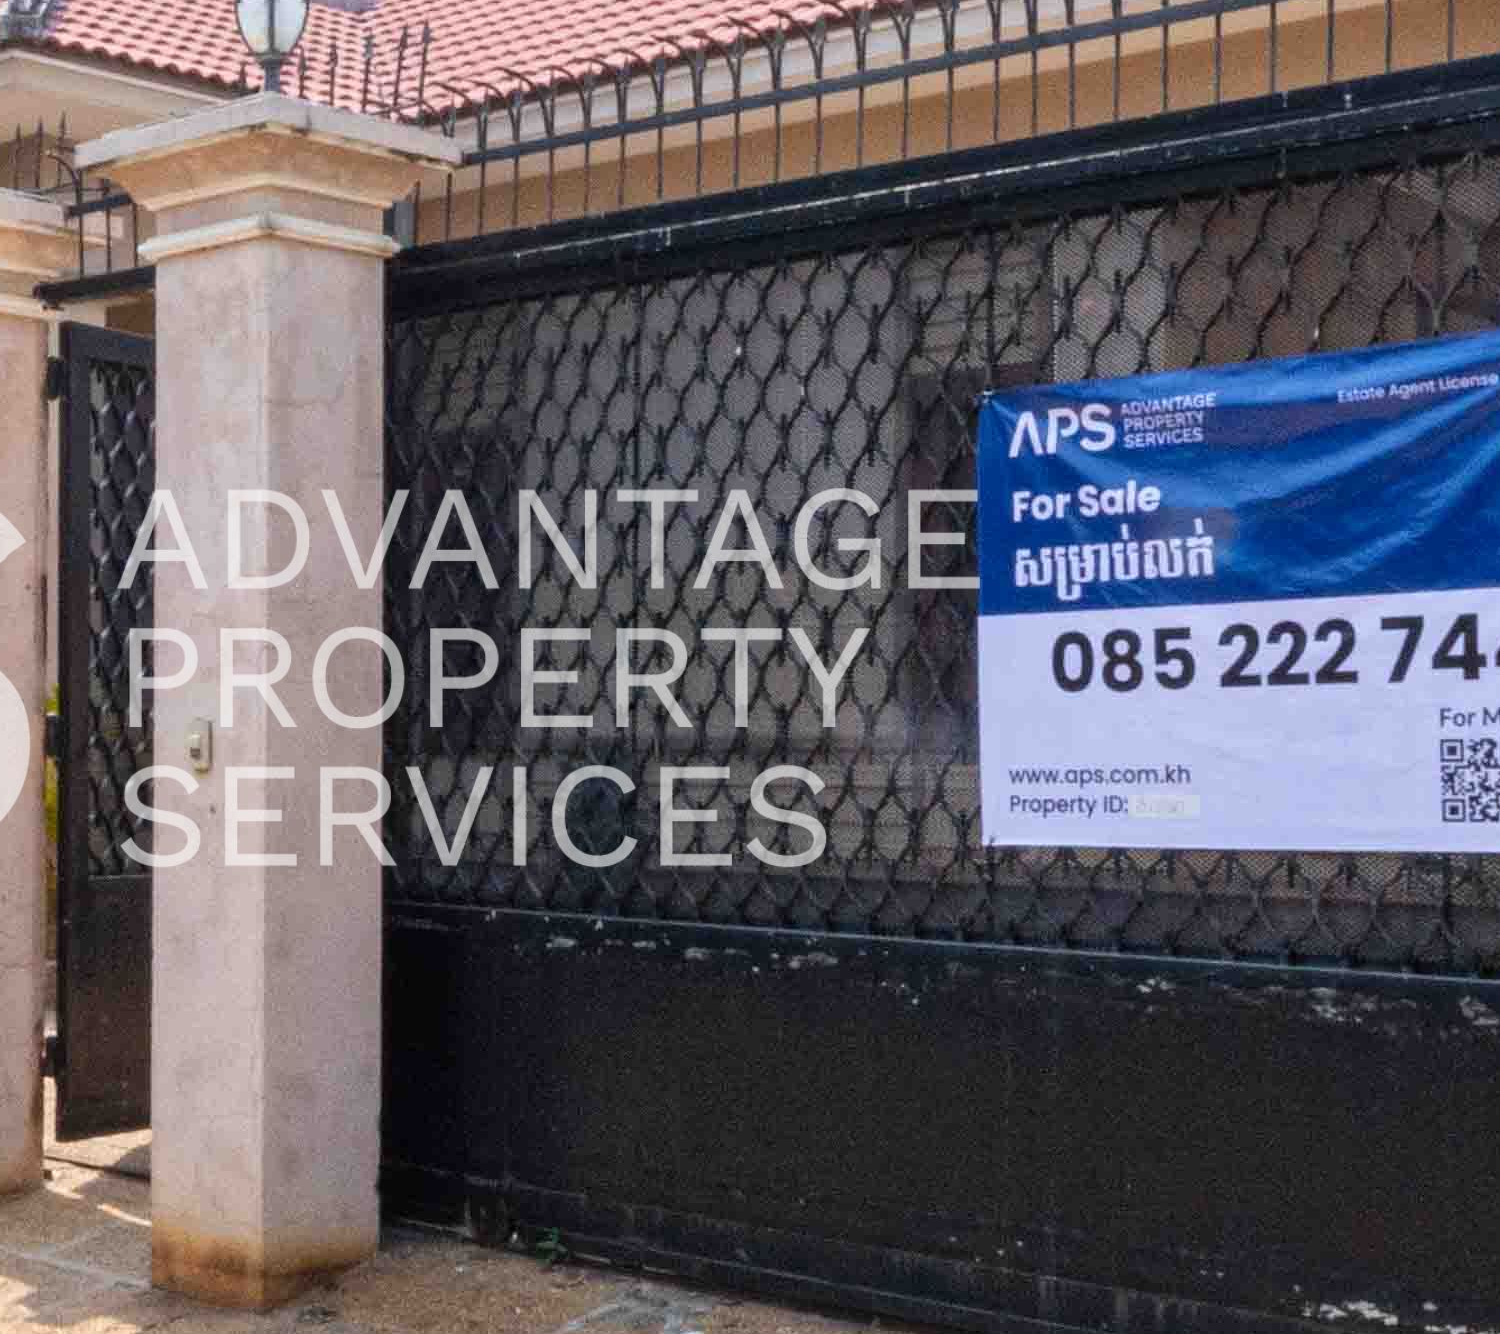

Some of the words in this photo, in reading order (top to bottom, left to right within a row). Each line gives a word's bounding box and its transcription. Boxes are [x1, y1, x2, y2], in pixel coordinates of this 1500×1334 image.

[1337, 387, 1384, 403] Estate
[1389, 380, 1435, 400] Agent
[1439, 374, 1499, 390] License
[1120, 393, 1216, 415] ADVANTAGE
[1008, 403, 1115, 458] APS
[1122, 411, 1204, 432] PROPERTY
[1123, 428, 1204, 449] SERVICES
[1012, 491, 1071, 522] For
[1077, 479, 1161, 517] Sale
[1051, 628, 1196, 692] 085
[1217, 618, 1359, 688] 222
[1439, 708, 1476, 728] For
[1009, 765, 1192, 787] www.aps.com.kh
[1009, 795, 1097, 819] Property
[1104, 795, 1129, 814] ID:
